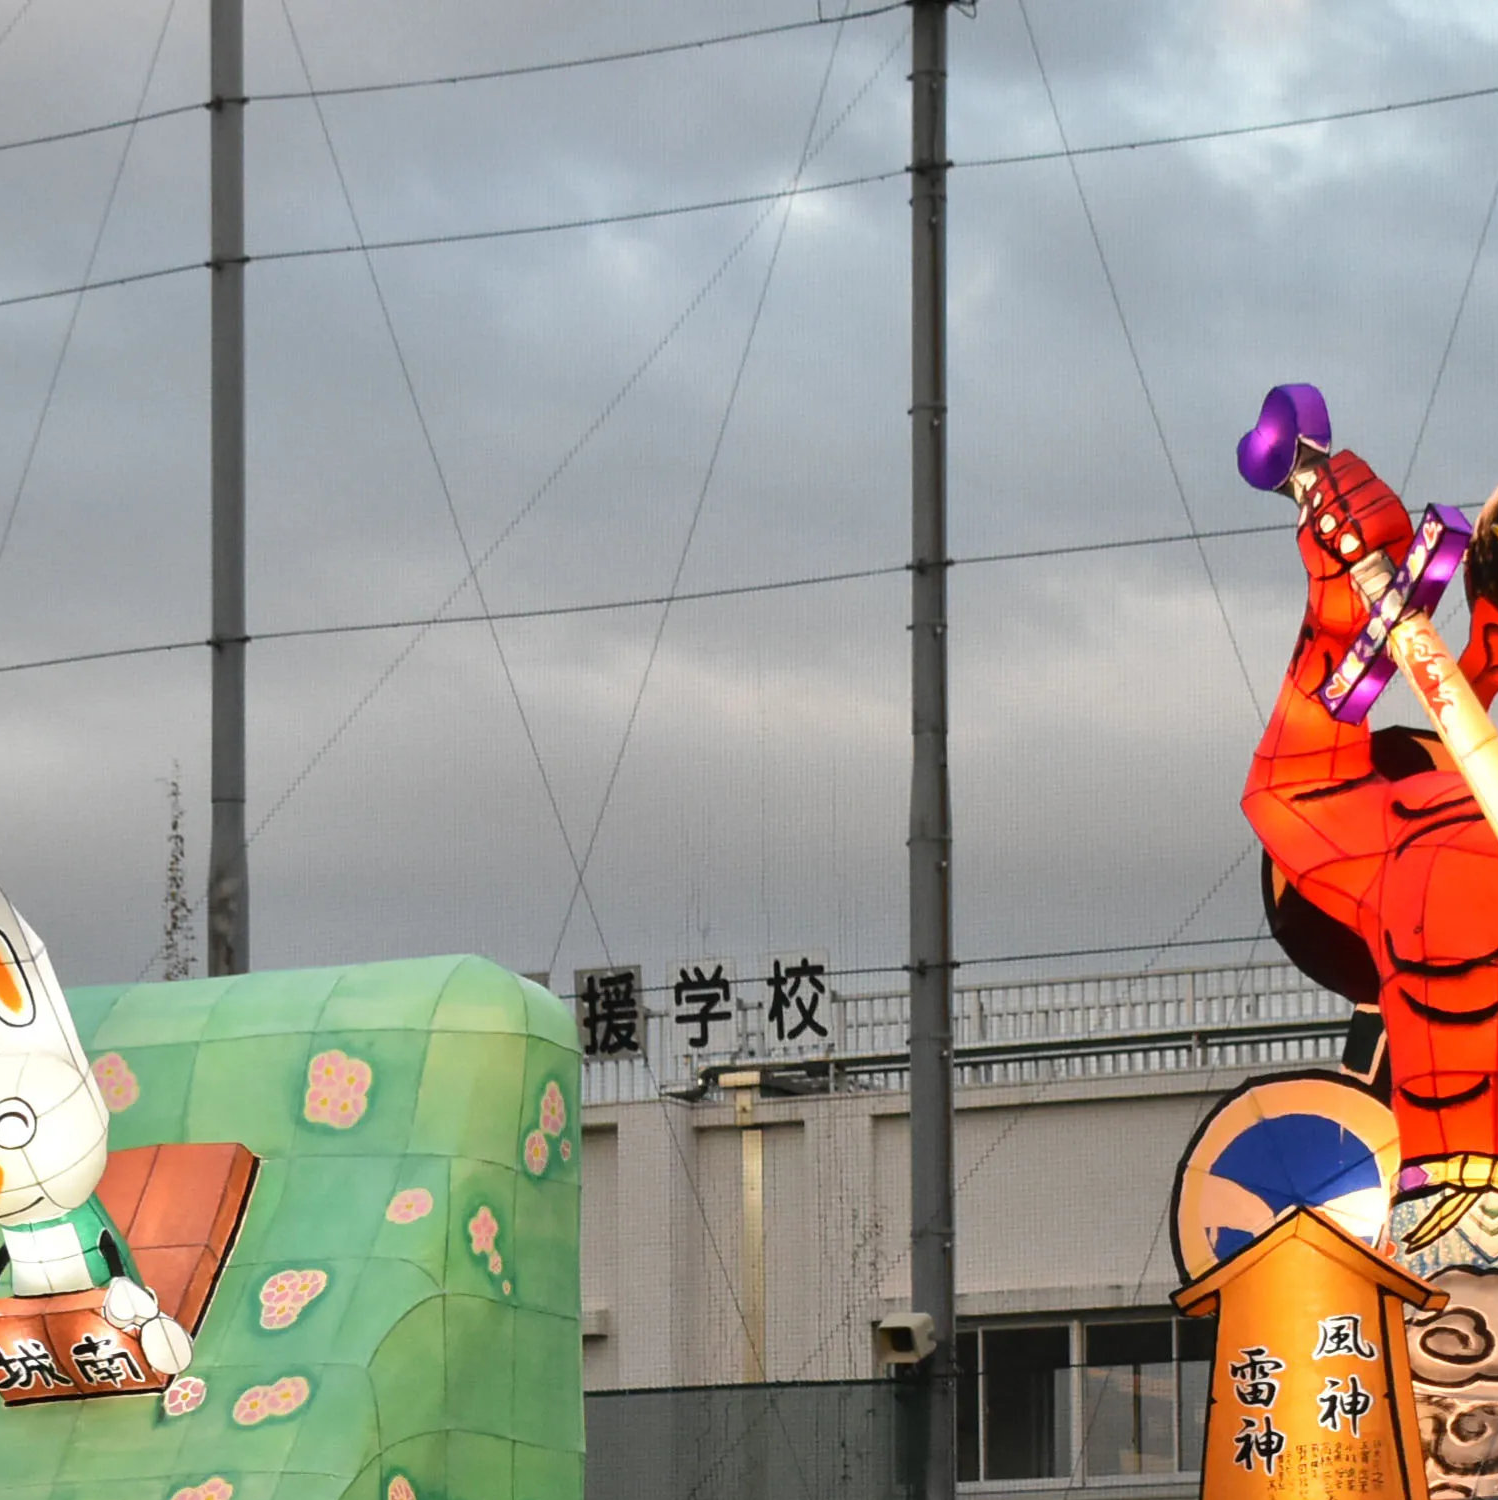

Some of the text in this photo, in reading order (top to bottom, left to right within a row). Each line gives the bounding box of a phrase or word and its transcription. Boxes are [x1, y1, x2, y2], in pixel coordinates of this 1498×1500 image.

[582, 958, 828, 1055] 援学校
[1230, 1348, 1284, 1475] 雷神
[1313, 1315, 1376, 1436] 風神
